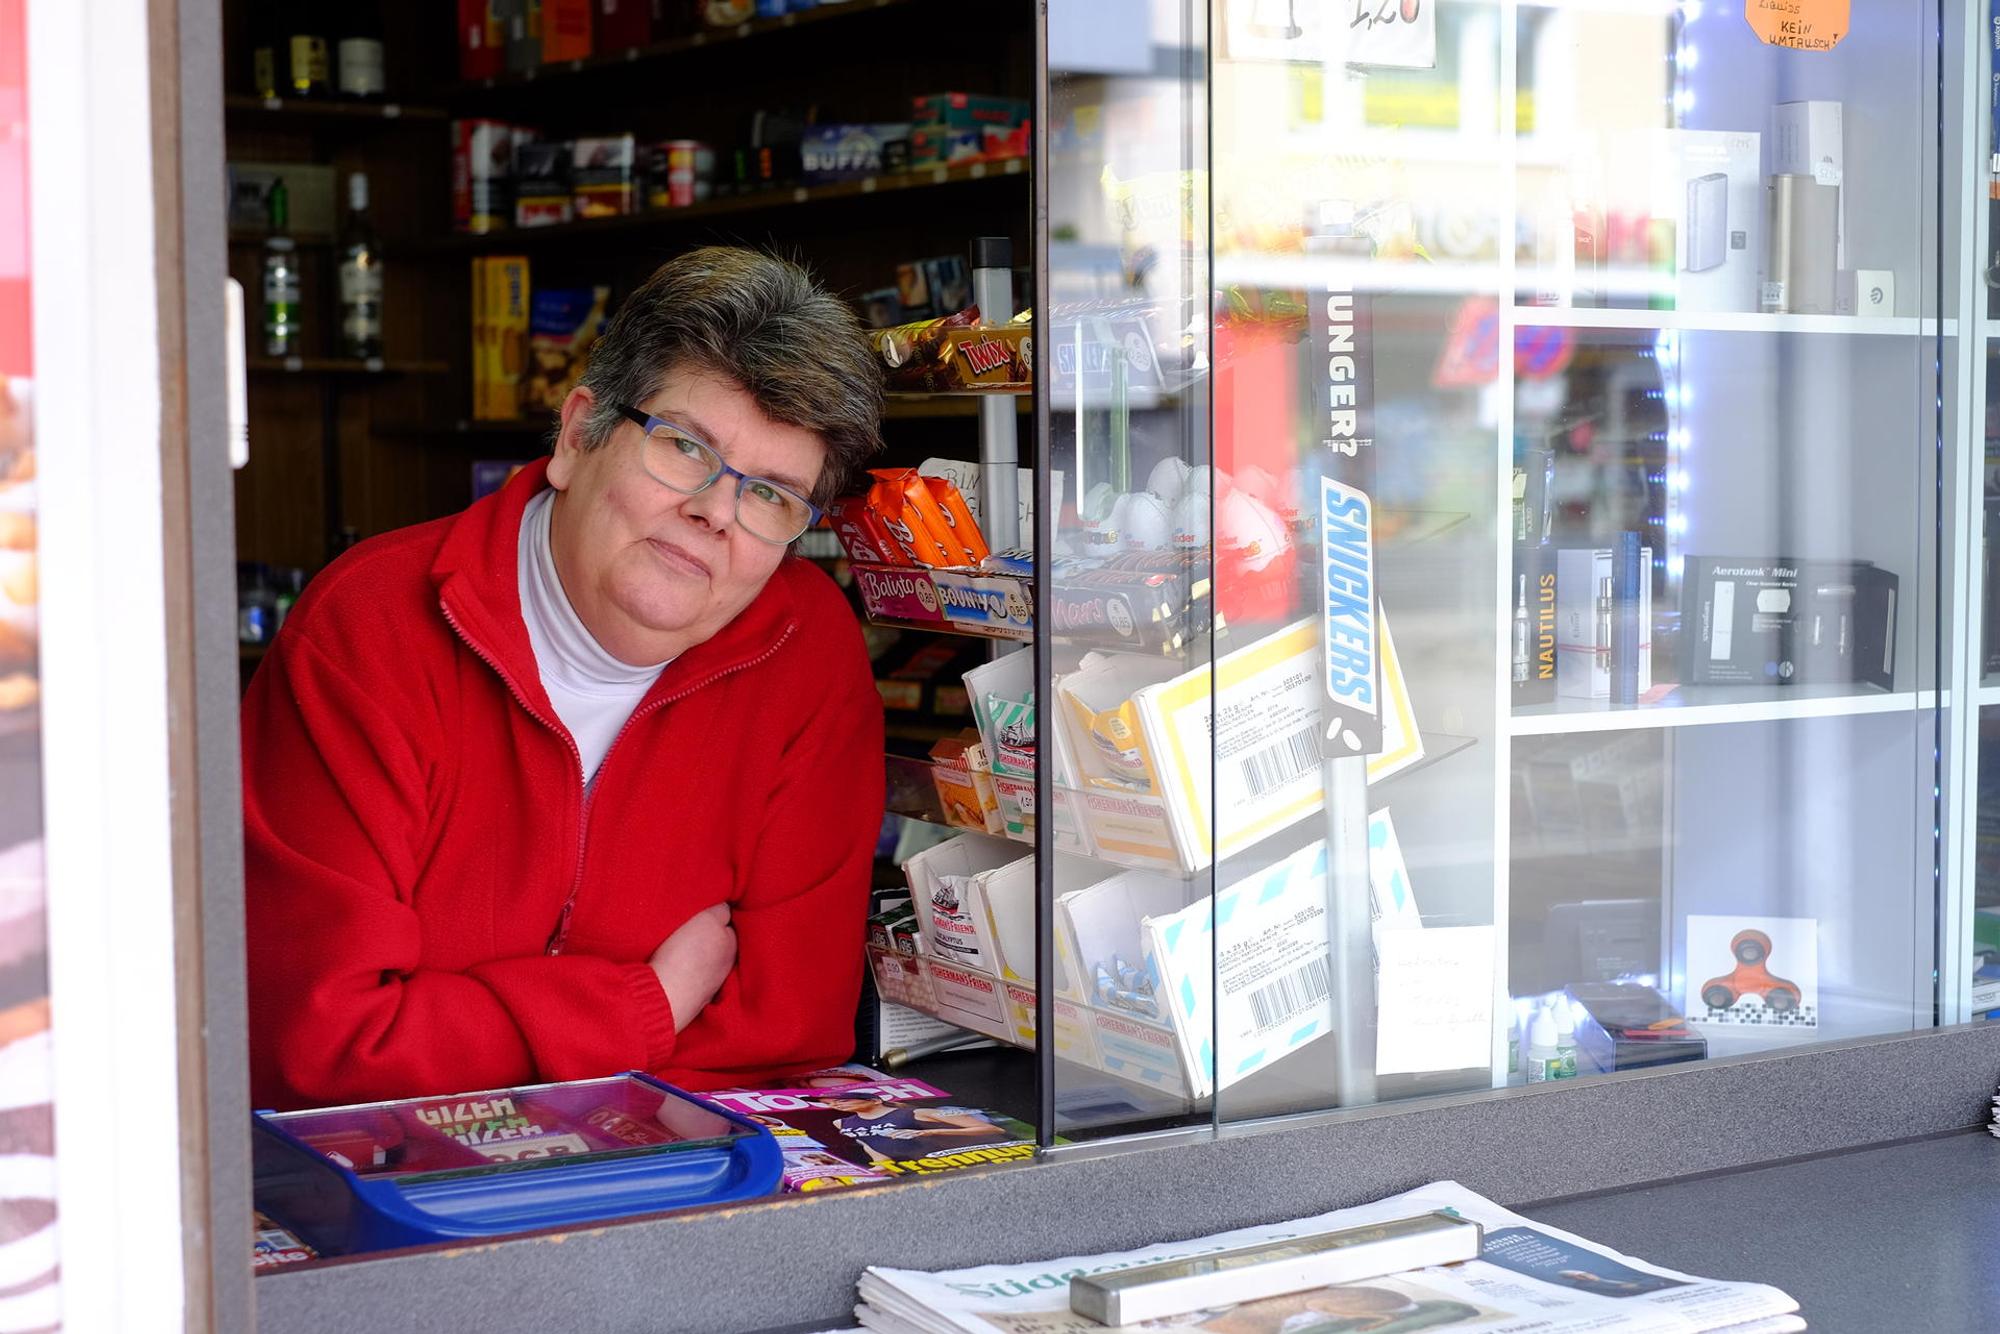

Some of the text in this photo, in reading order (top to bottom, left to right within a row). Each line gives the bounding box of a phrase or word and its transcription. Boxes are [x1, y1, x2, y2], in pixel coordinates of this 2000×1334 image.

[959, 334, 1010, 375] Twix
[1327, 281, 1357, 457] UNGER?
[864, 572, 915, 600] Balisto
[938, 587, 989, 612] BOUNTY
[1326, 488, 1372, 704] SNICKERS
[1537, 573, 1555, 680] NAUTILUS
